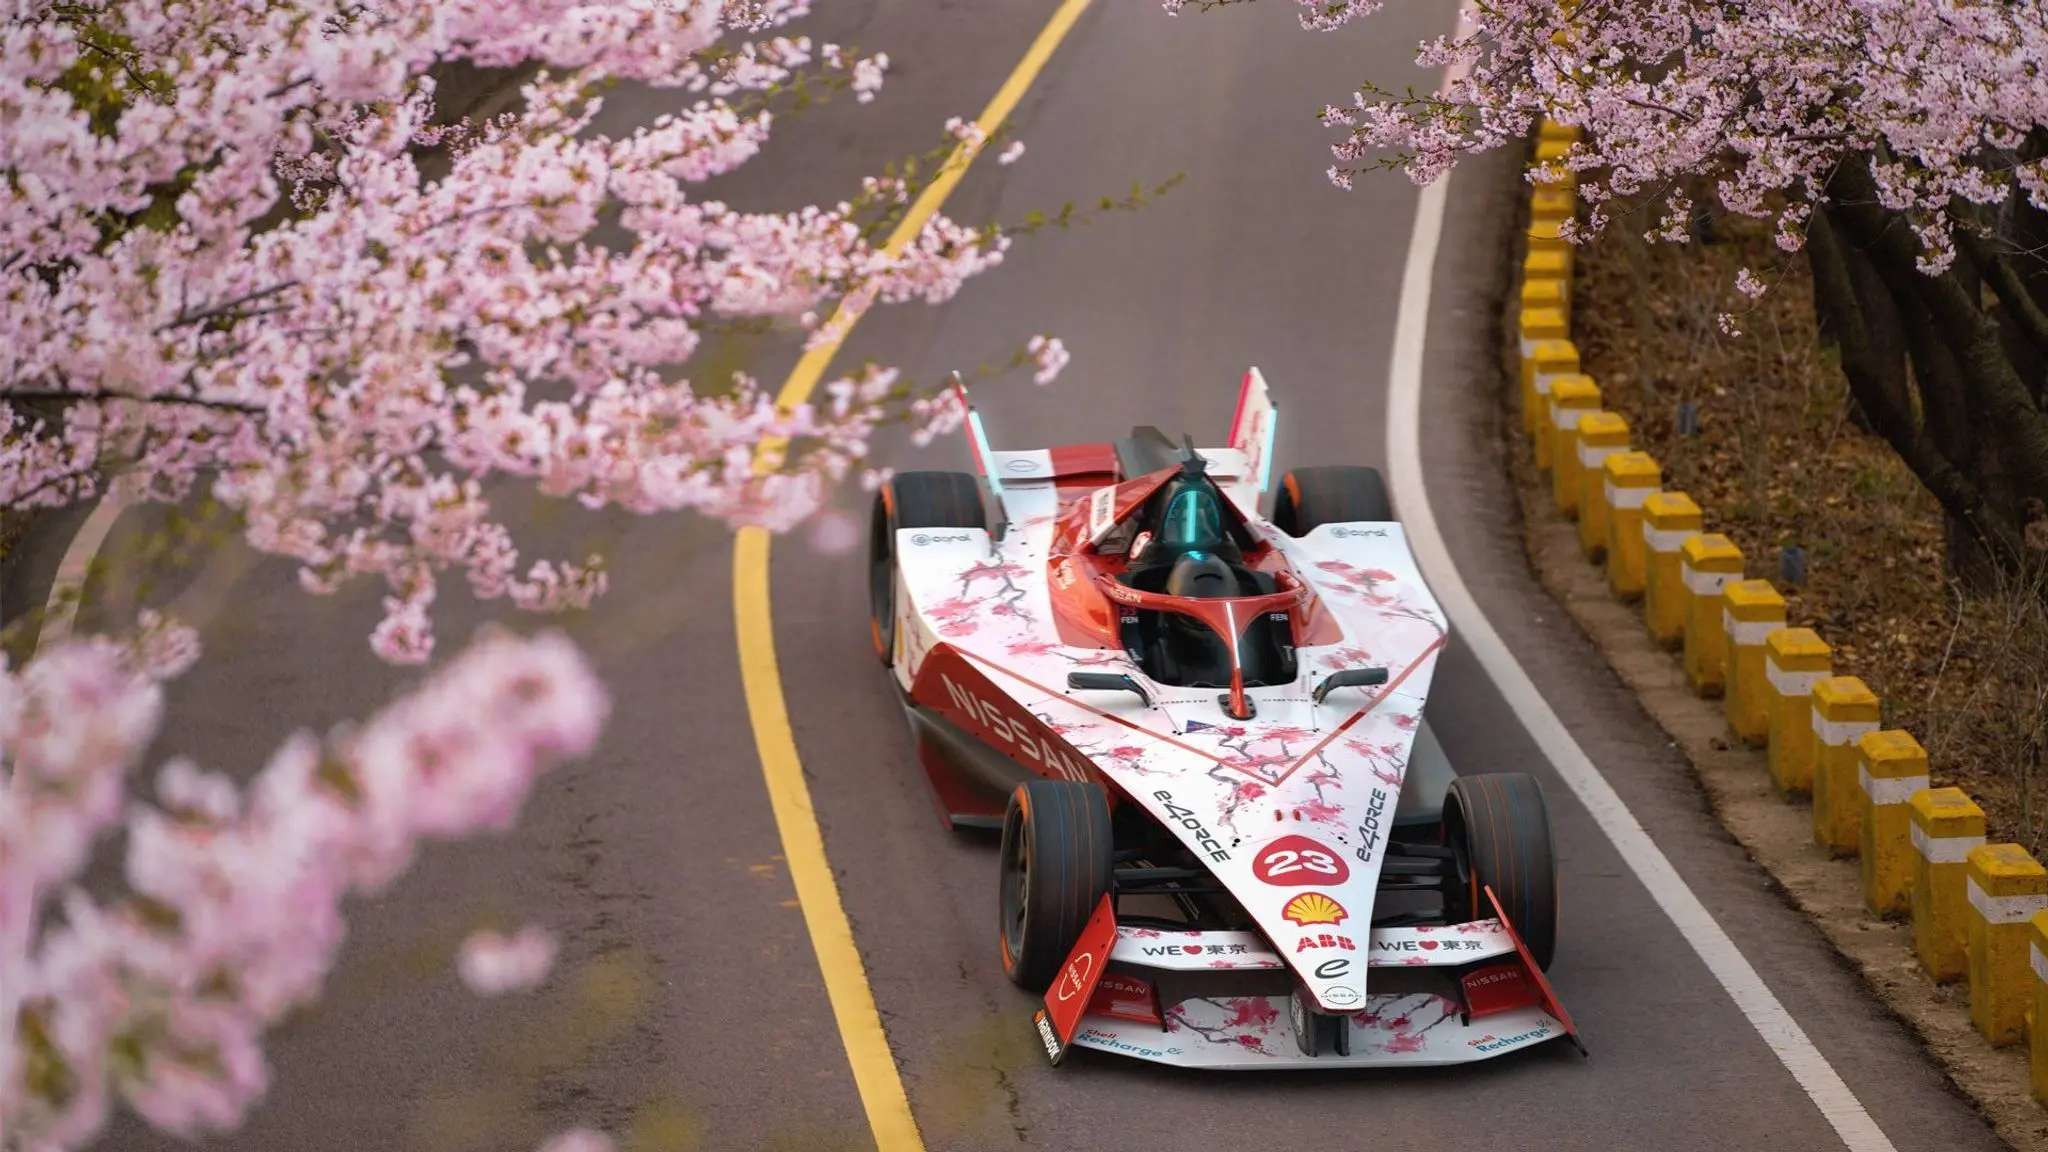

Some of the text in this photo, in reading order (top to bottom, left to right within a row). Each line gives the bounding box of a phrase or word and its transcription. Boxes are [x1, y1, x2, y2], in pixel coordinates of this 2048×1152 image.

[940, 672, 1090, 784] NISSAN
[1263, 849, 1338, 877] 23
[1141, 943, 1249, 956] WE 東京
[1296, 934, 1356, 953] ABB
[1377, 939, 1485, 952] WE 東京
[1067, 962, 1083, 992] NISSAN
[1466, 970, 1519, 989] NISSAN
[1098, 980, 1146, 995] ISSAN
[1085, 1029, 1117, 1039] Shell
[1467, 1034, 1496, 1047] Shell
[1475, 1028, 1551, 1053] Recharge
[1078, 1033, 1163, 1057] Recharge
